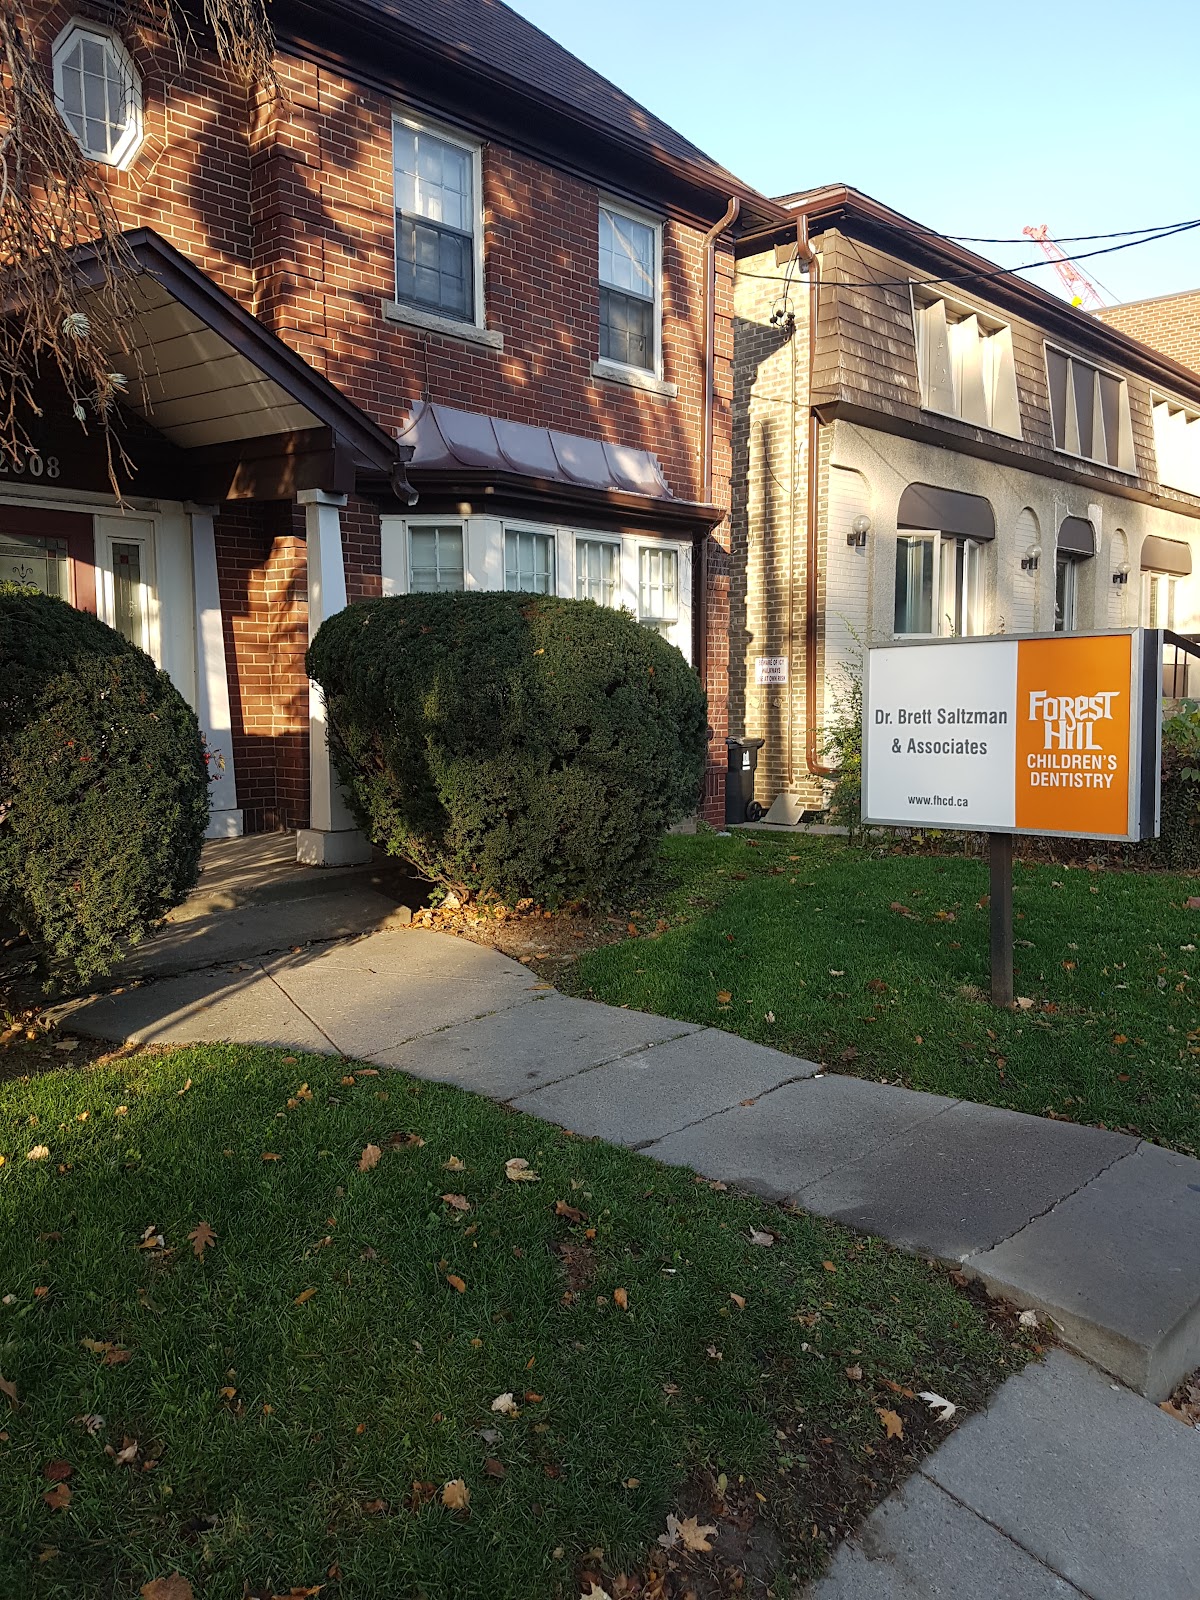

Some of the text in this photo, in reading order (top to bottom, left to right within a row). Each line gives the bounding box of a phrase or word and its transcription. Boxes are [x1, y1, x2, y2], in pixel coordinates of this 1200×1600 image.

[875, 708, 1008, 725] Dr. Brett Saltzman
[891, 738, 988, 755] & Associates
[1027, 753, 1118, 770] CHILDREN'S
[1030, 771, 1114, 789] DENTISTRY
[907, 795, 969, 807] www.fhcd.ca
